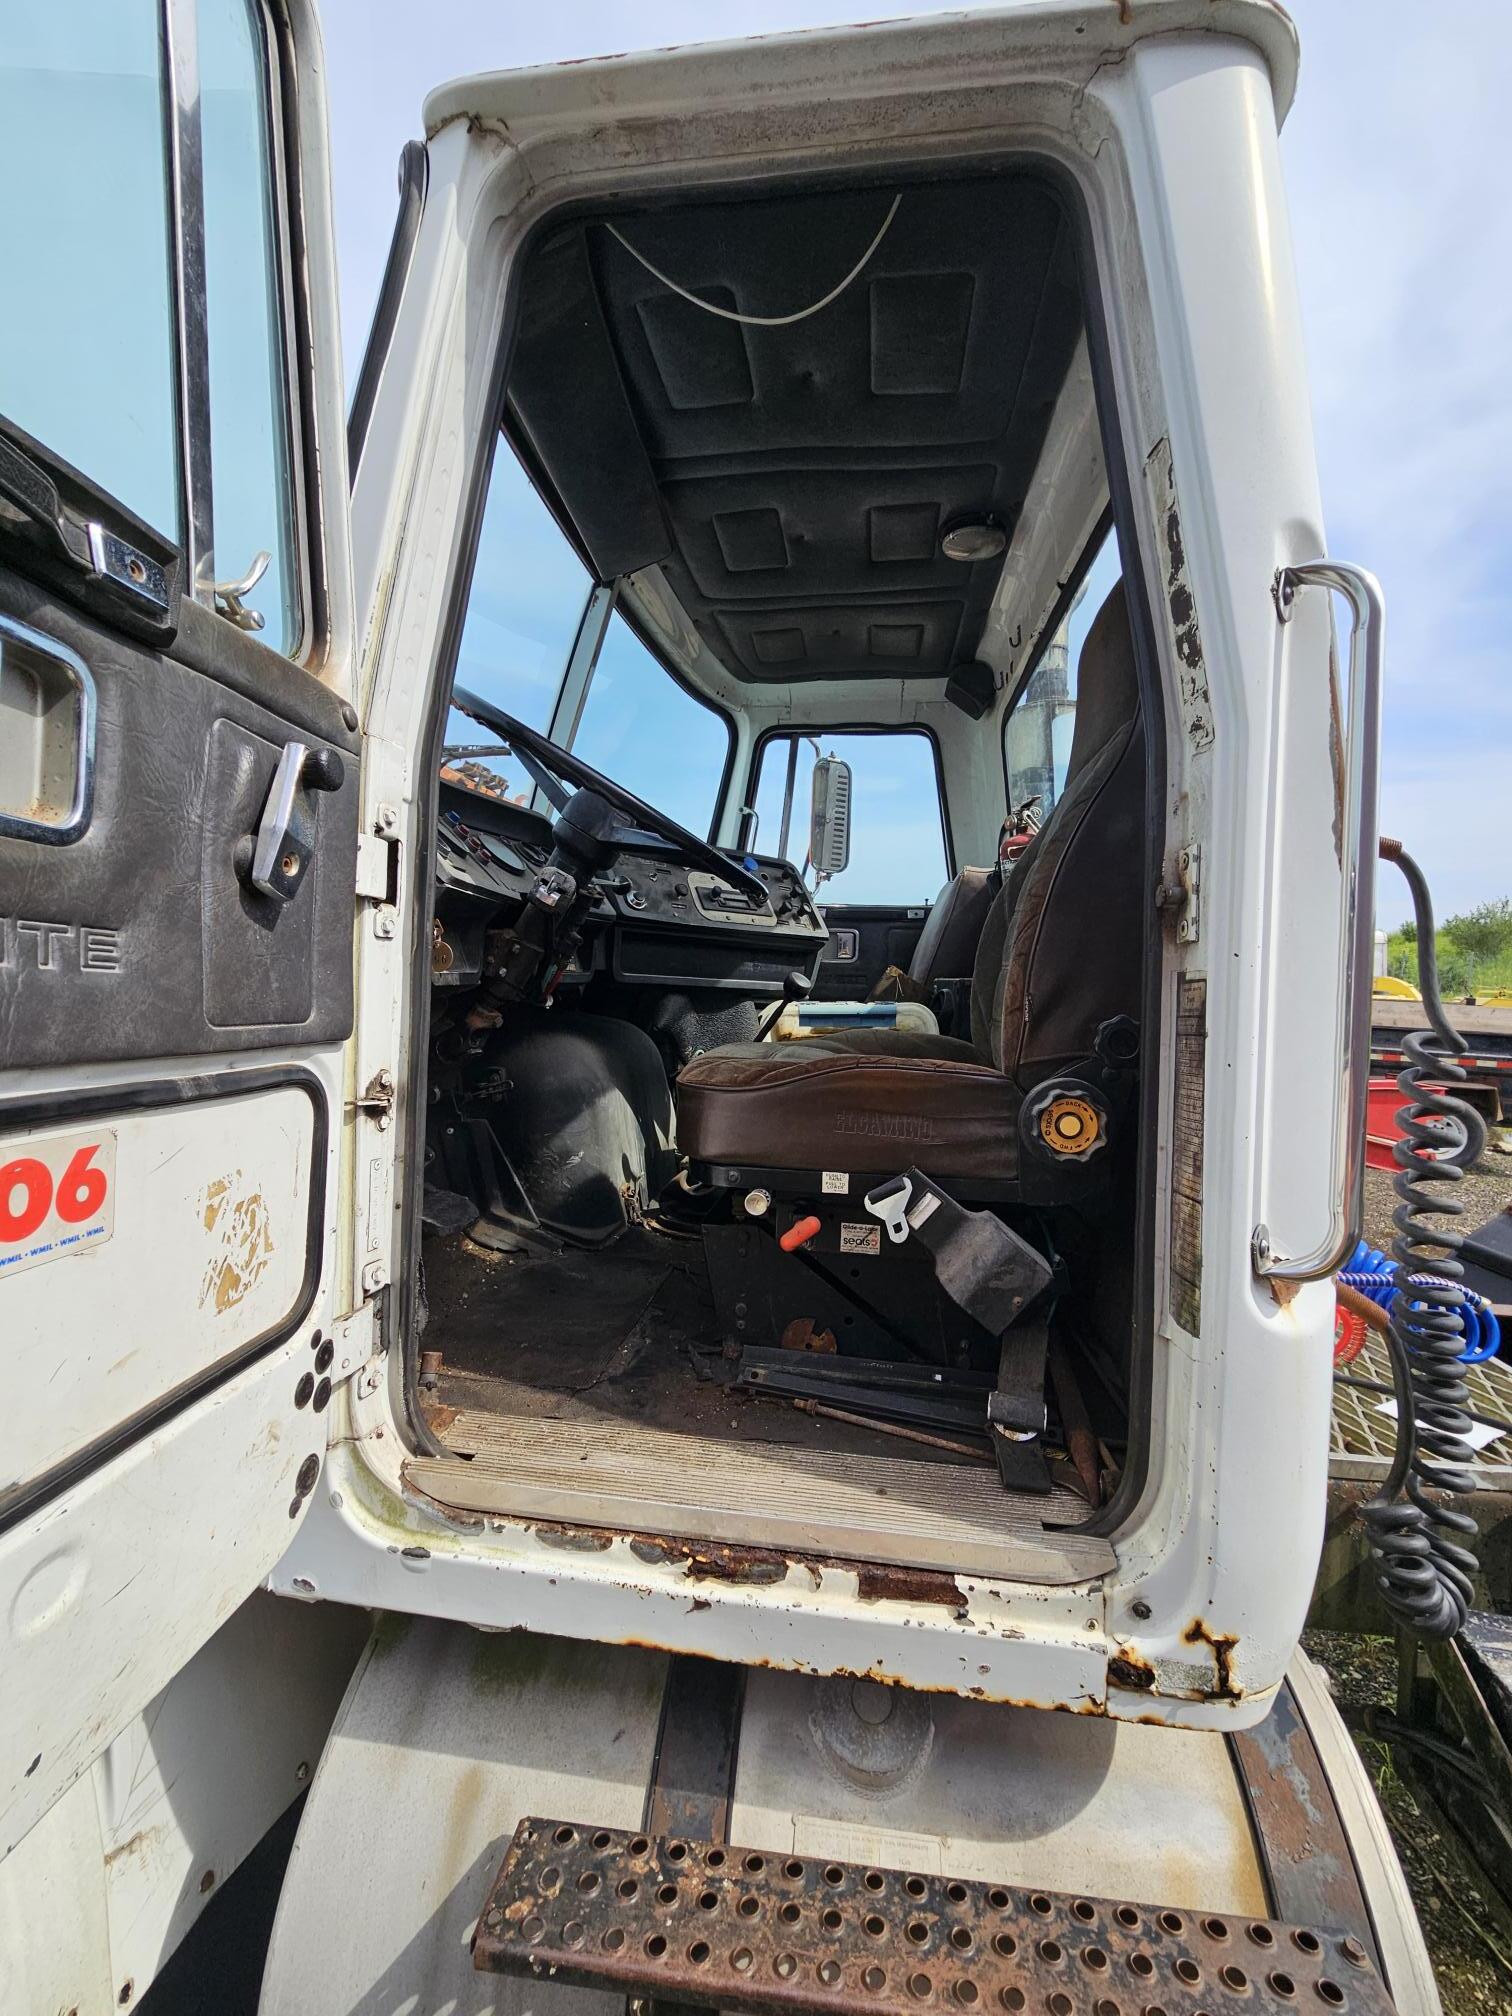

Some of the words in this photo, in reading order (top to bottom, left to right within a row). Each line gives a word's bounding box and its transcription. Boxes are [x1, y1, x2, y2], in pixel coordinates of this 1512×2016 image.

[30, 1243, 54, 1256] WMIL
[60, 1234, 81, 1247] WMIL
[86, 1226, 105, 1237] WMIL
[843, 1237, 871, 1246] seats
